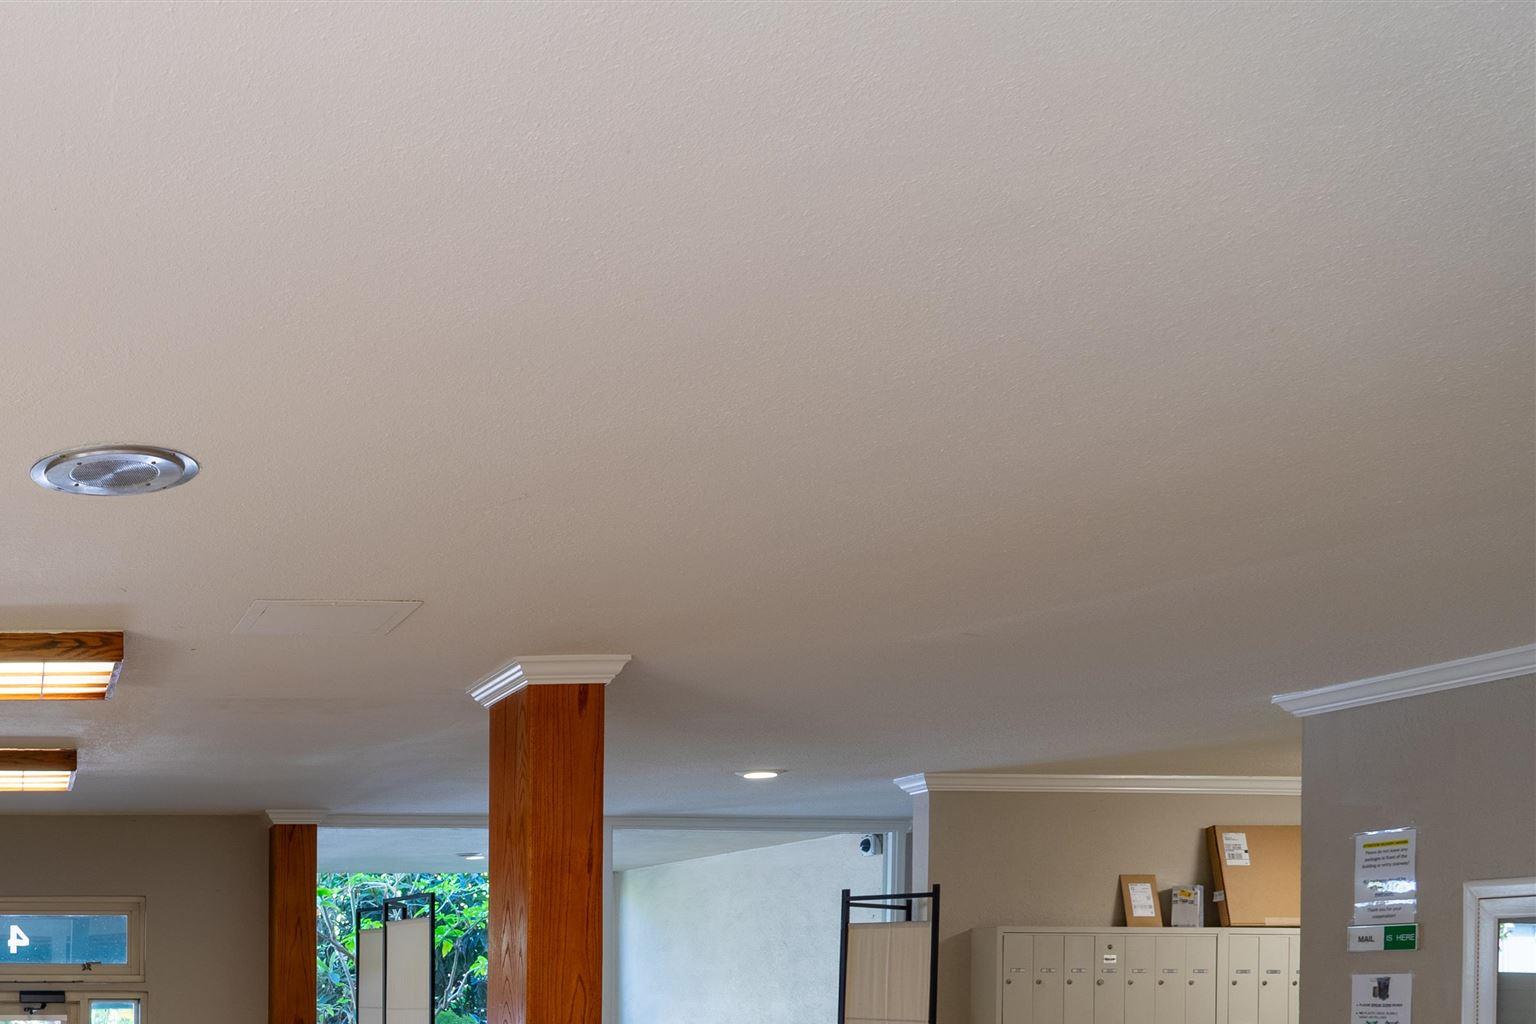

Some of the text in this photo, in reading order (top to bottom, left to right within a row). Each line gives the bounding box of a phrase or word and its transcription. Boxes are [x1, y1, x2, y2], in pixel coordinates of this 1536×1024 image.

[1358, 933, 1416, 943] MAIL IS HERE
